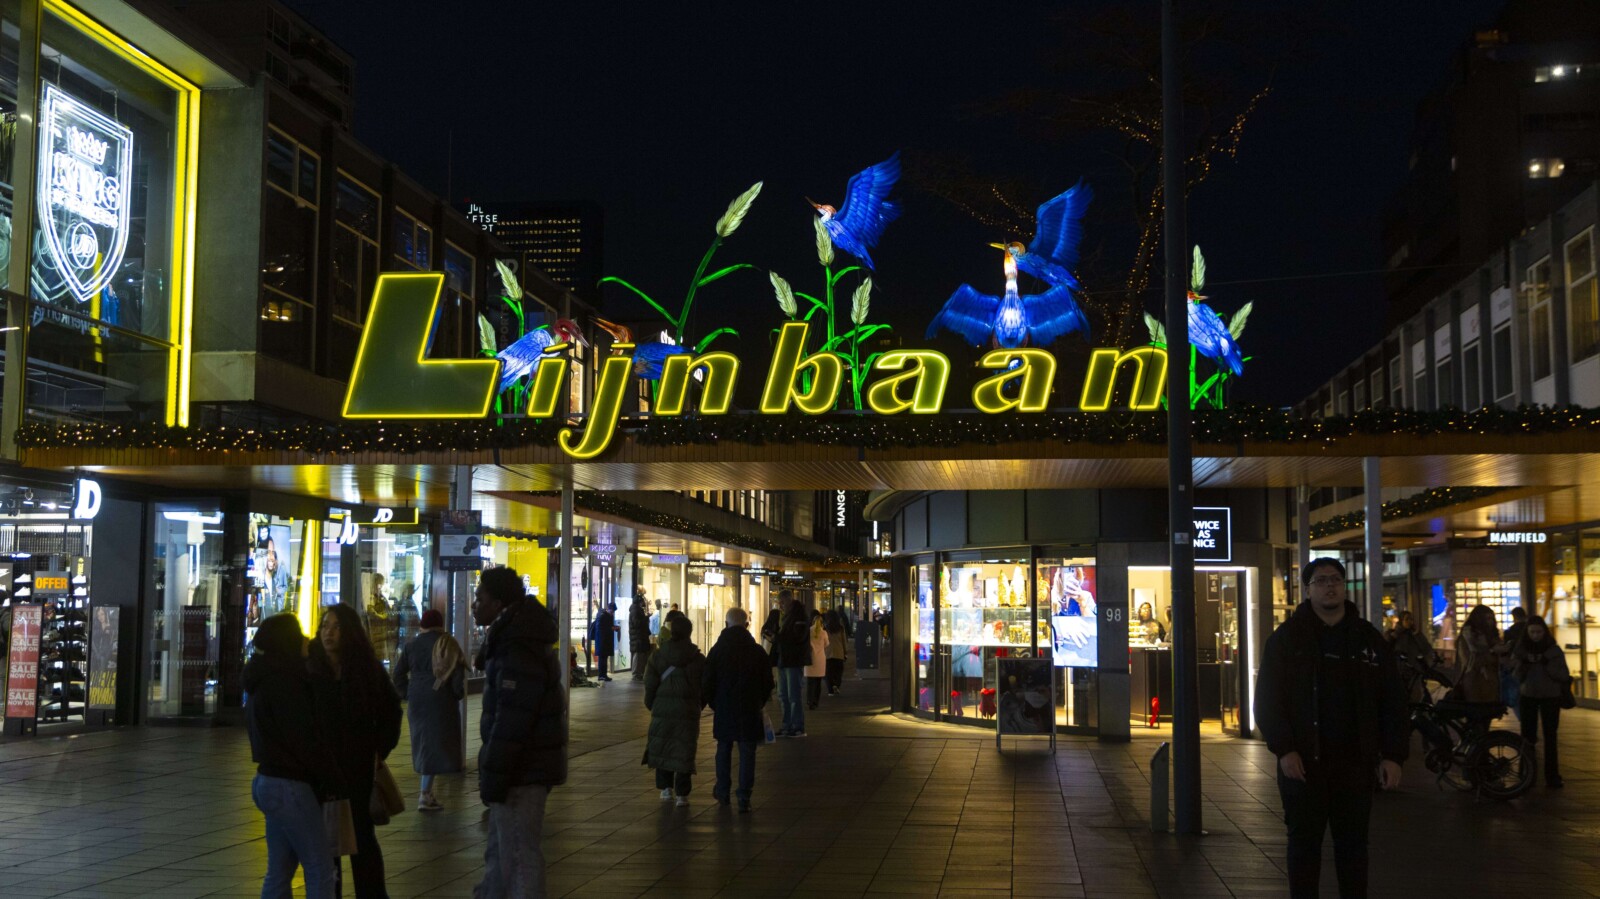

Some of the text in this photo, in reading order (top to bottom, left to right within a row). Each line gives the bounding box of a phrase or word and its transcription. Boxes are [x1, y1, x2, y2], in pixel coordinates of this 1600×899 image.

[342, 271, 1168, 458] Lijnbaan
[372, 507, 393, 522] JD
[1198, 530, 1211, 538] AS
[1490, 532, 1547, 543] MANFIELD
[1193, 539, 1216, 548] NICE
[591, 544, 617, 553] KIKO
[35, 577, 68, 589] OFFER
[15, 611, 41, 620] SALE
[1105, 608, 1122, 622] 98
[11, 665, 37, 673] SALE
[9, 692, 35, 700] SALE
